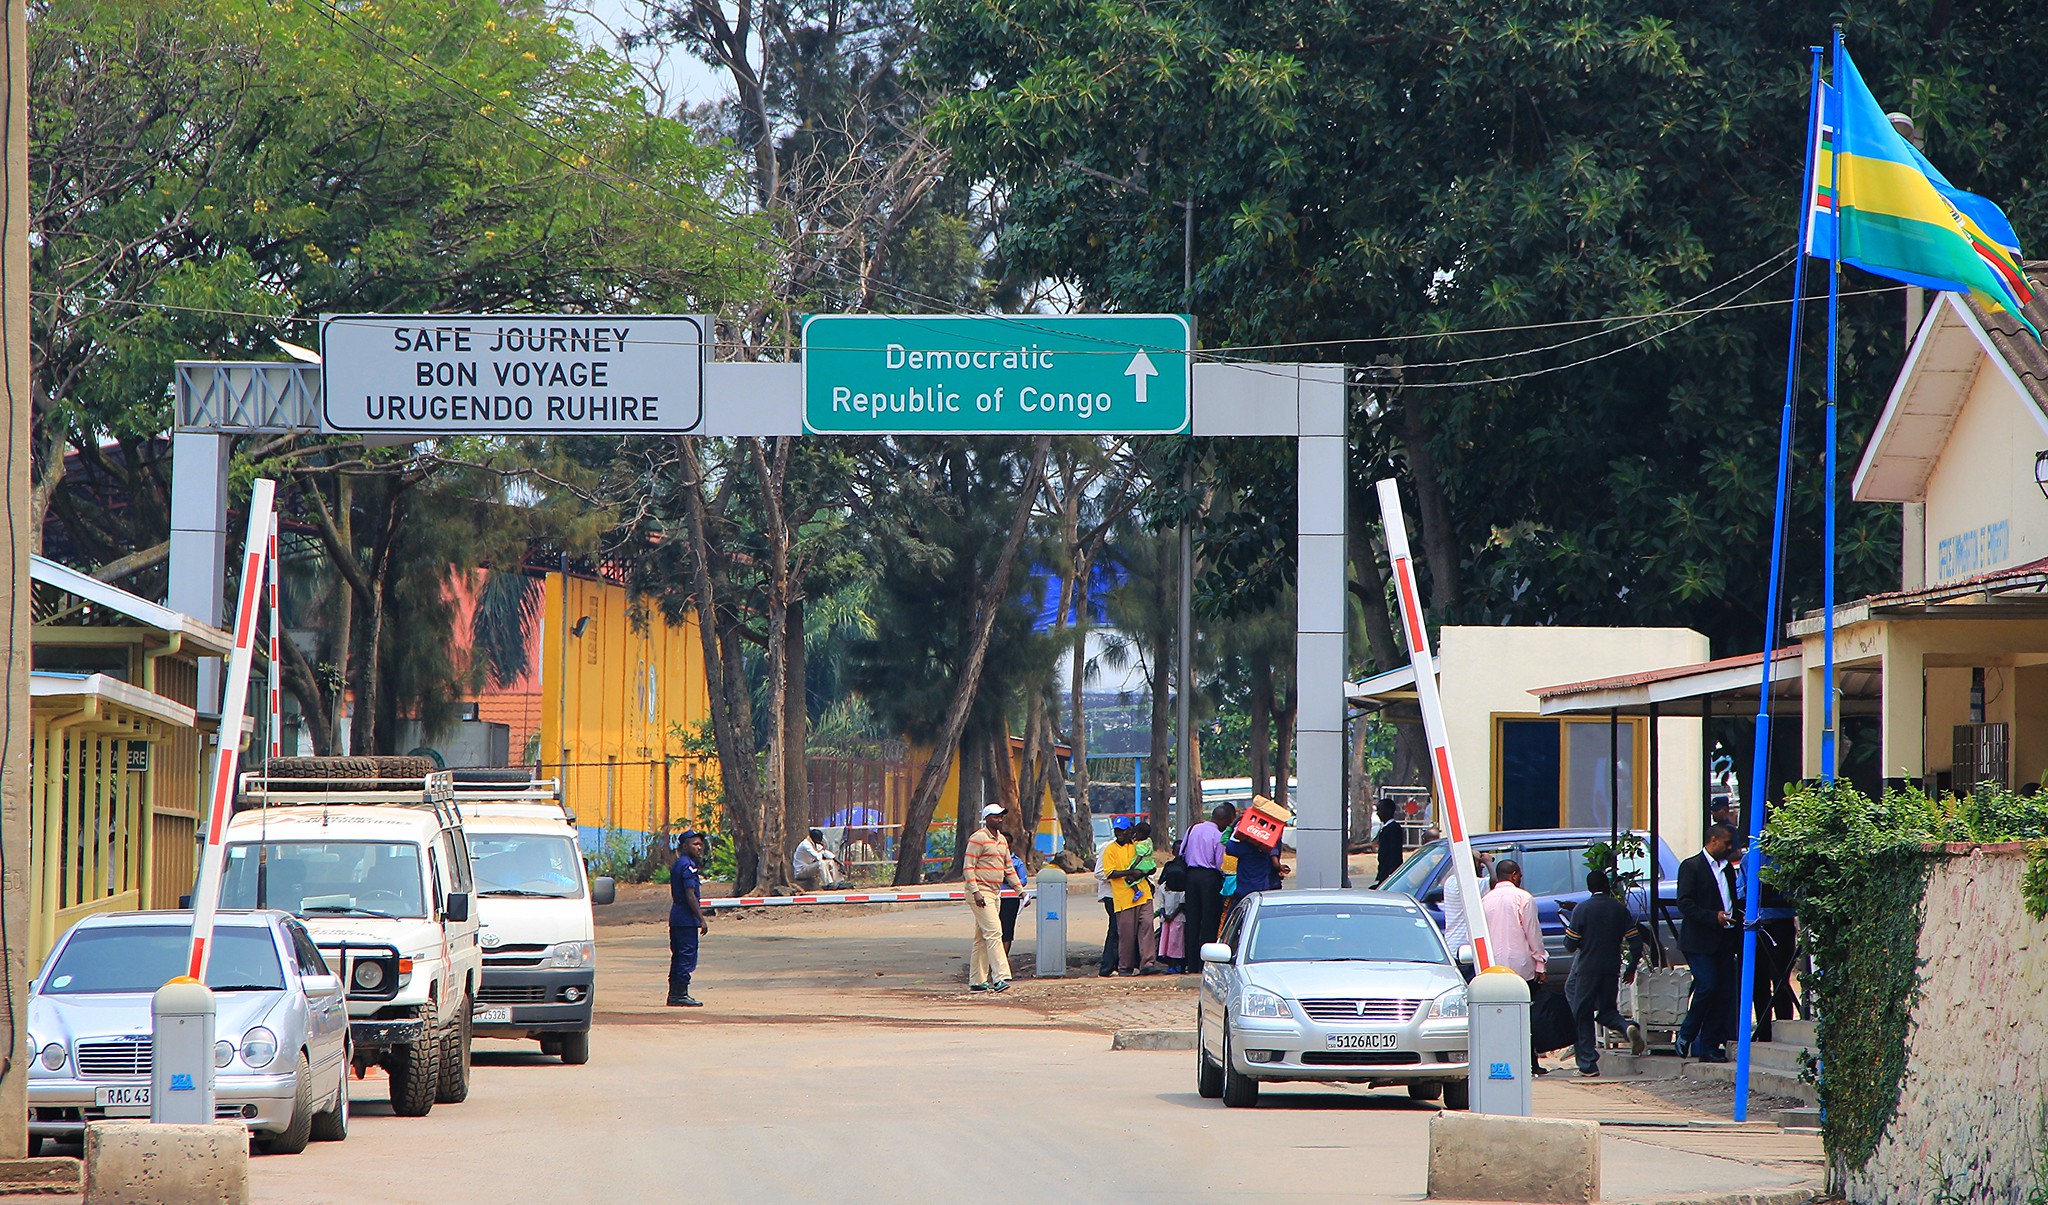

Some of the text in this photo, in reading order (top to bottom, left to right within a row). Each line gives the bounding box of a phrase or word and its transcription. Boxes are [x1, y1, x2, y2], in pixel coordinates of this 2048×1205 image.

[394, 327, 630, 352] SAFE JOURNEY
[886, 343, 1054, 369] Democratic
[416, 361, 608, 387] BON VOYAGE
[366, 396, 659, 421] URUGENDO RUHIRE
[832, 384, 1112, 418] Republic of Congo
[1336, 1035, 1396, 1048] 5126AC 19
[108, 1089, 131, 1104] RAC
